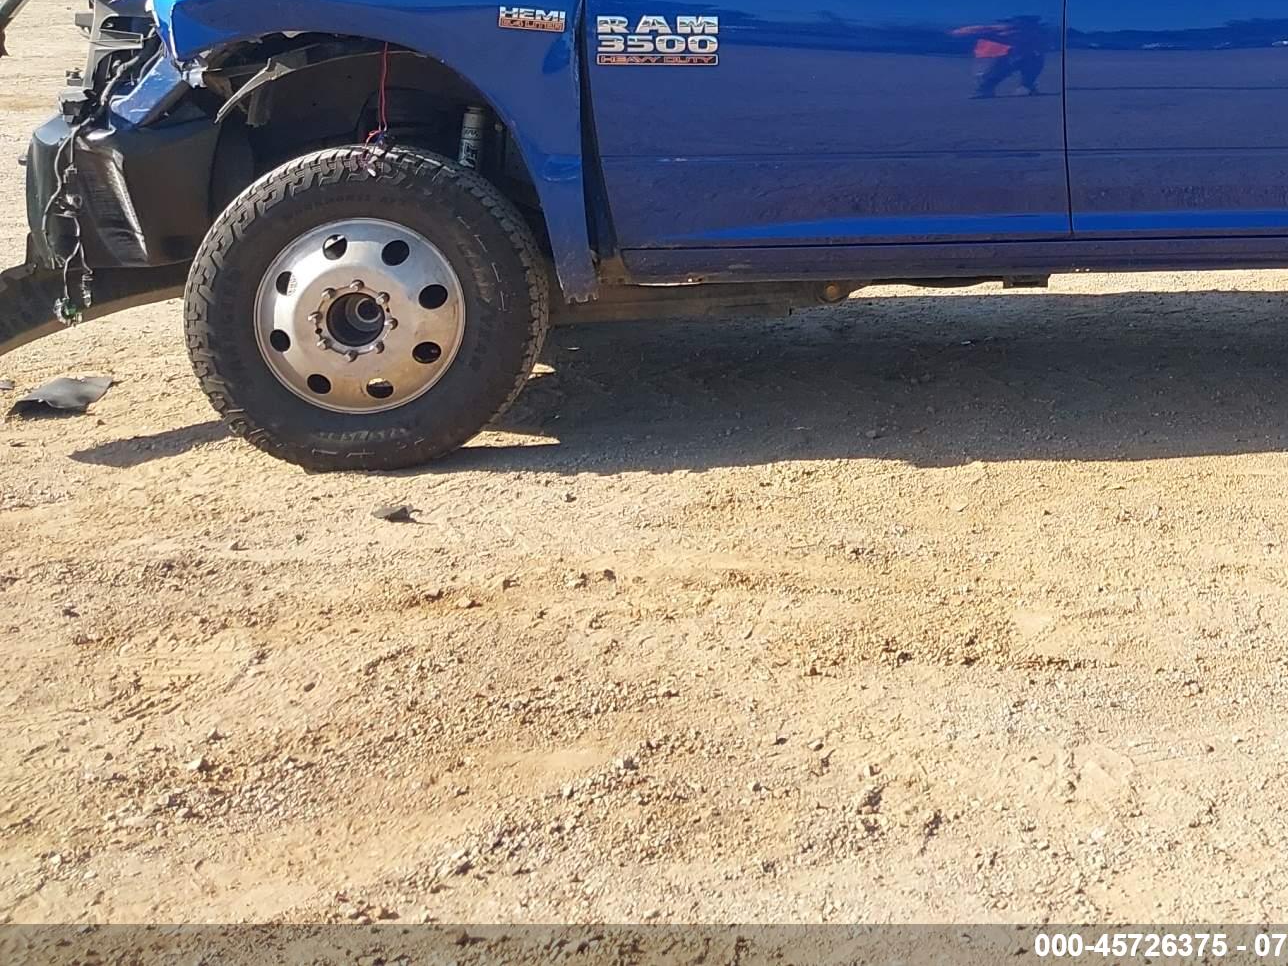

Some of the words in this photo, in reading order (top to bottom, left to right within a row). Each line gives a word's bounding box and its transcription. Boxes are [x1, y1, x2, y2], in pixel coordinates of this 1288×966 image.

[499, 6, 566, 23] HEMI
[596, 15, 719, 34] RAM
[597, 34, 719, 53] 3500
[600, 55, 661, 64] HEAVY
[663, 55, 715, 64] DUTY
